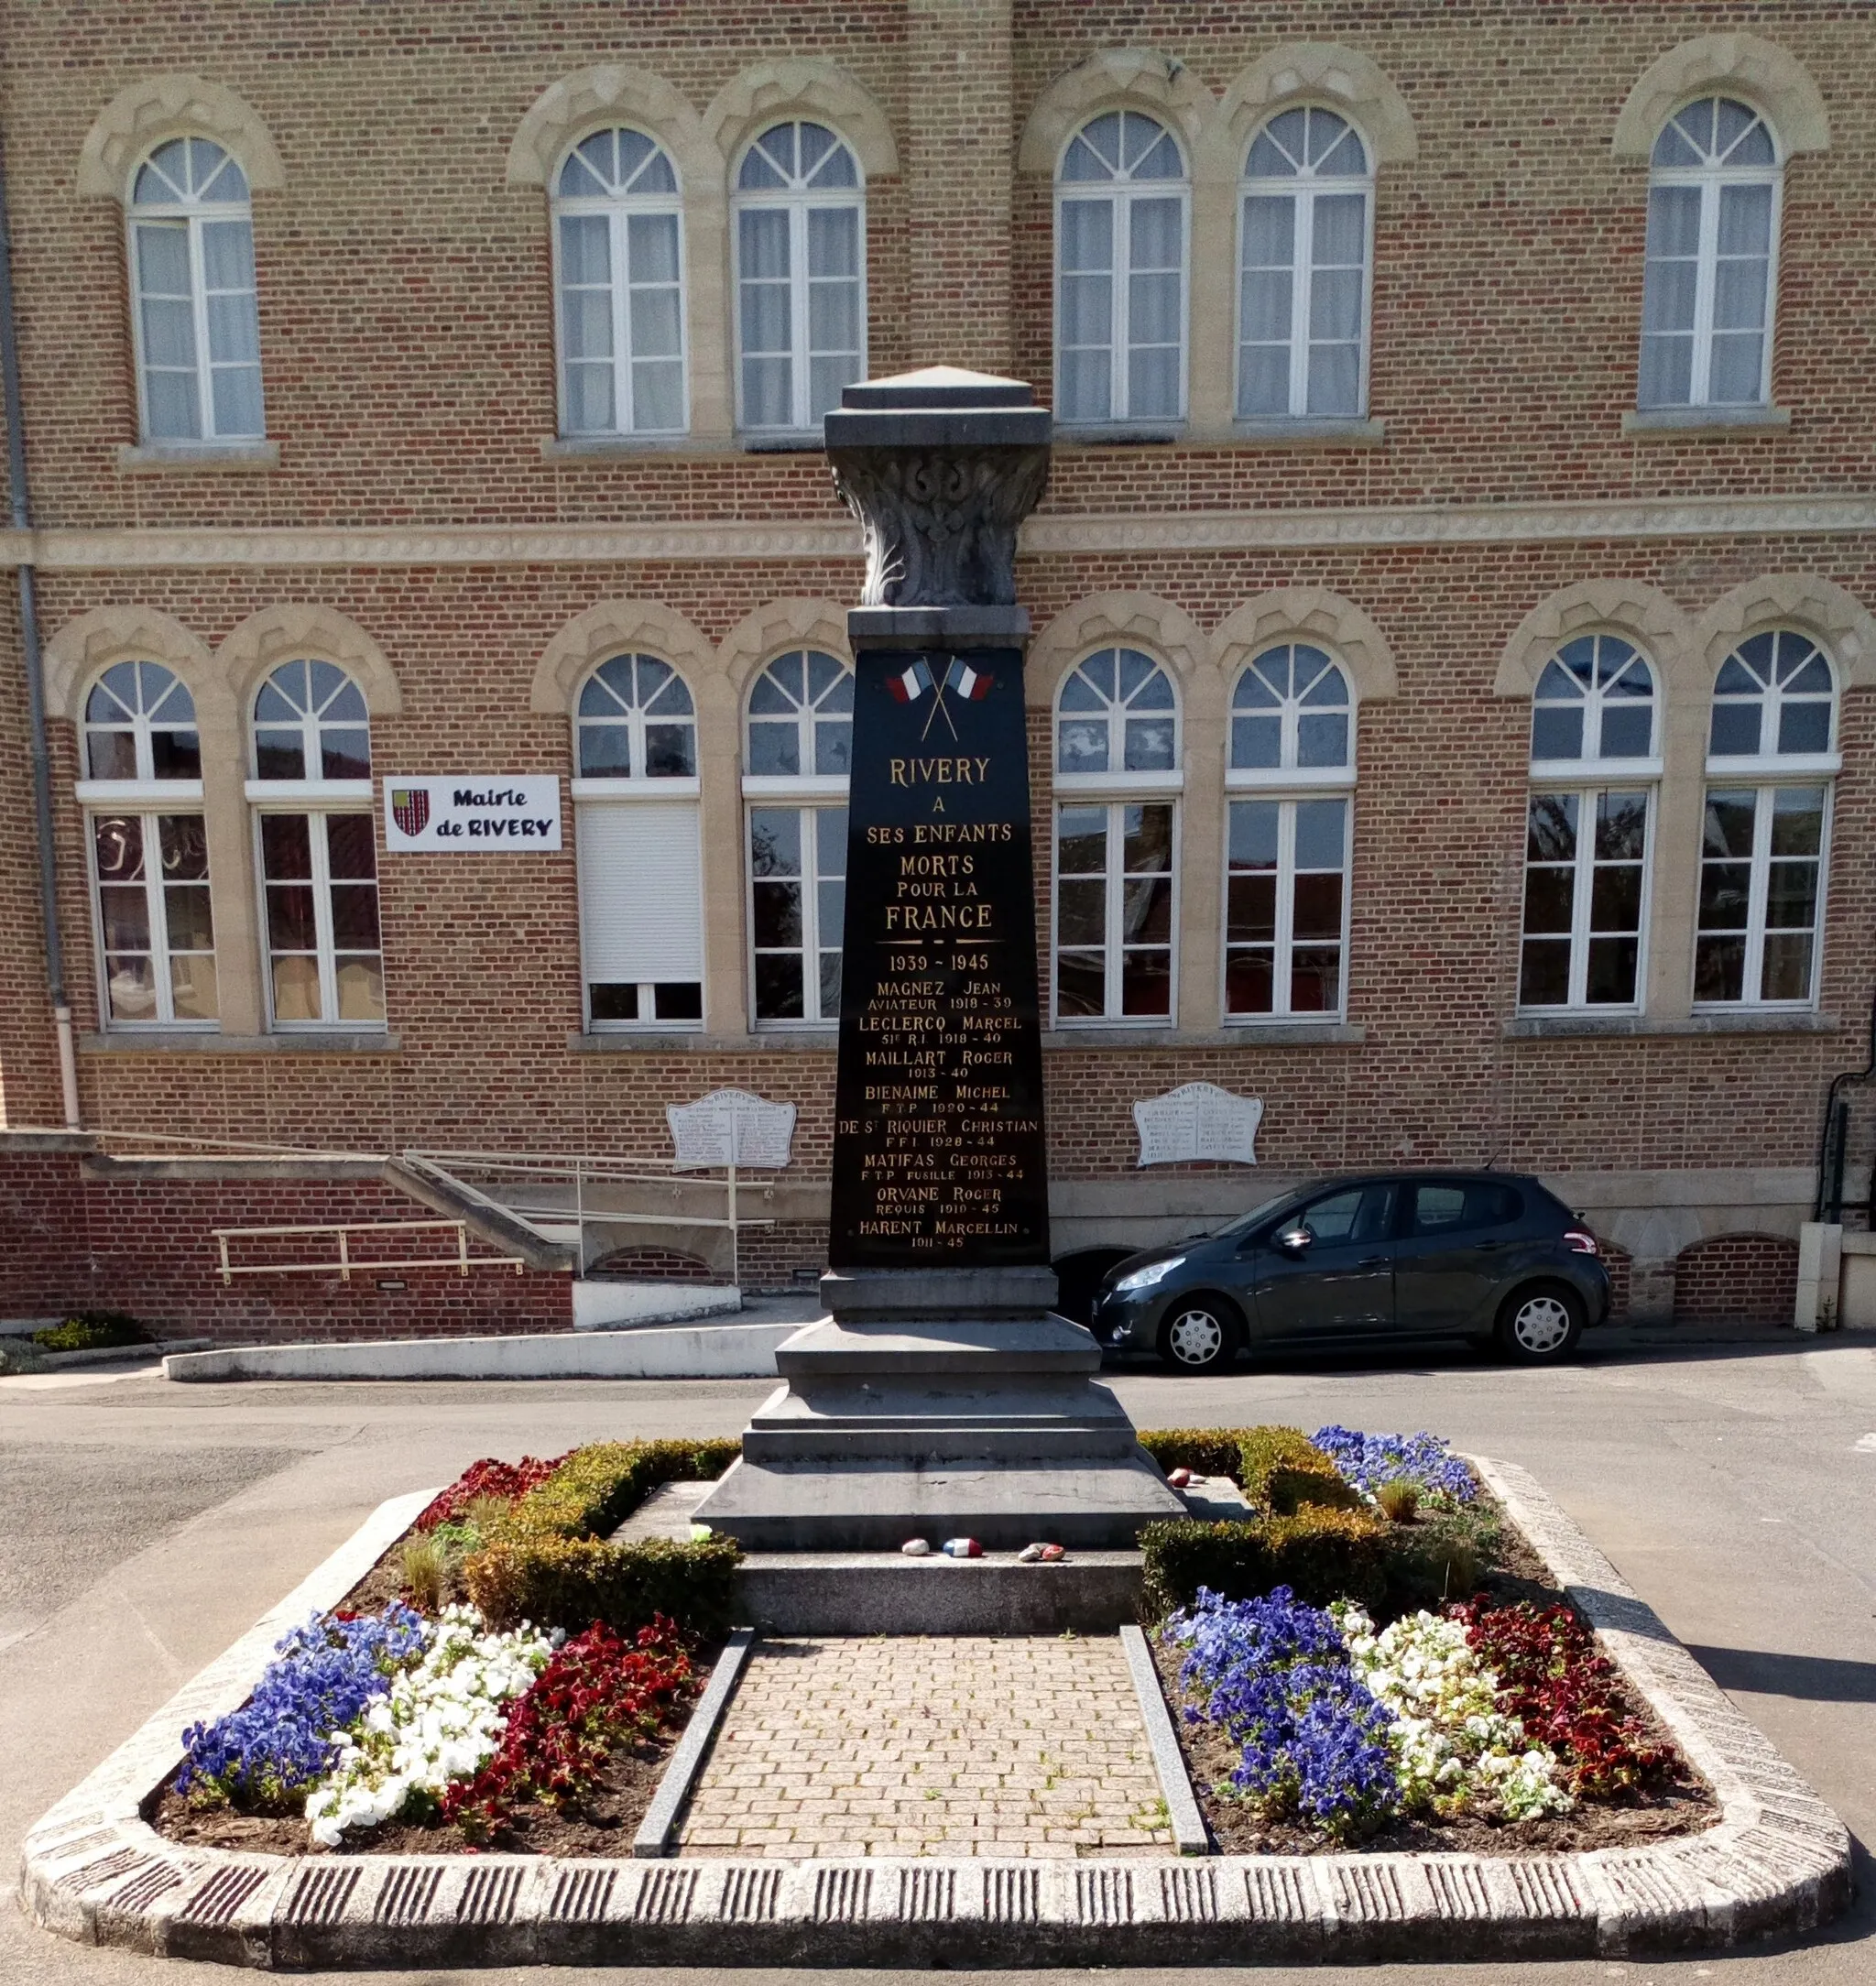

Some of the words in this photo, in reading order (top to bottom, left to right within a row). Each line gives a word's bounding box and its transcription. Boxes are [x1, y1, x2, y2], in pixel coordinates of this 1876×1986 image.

[889, 758, 991, 788] RIVERY
[453, 789, 528, 807] Mairie
[933, 796, 945, 813] A
[436, 819, 464, 837] de
[468, 819, 553, 837] RIVERY
[867, 826, 904, 844] SES
[914, 824, 1012, 844] ENFANTS
[900, 856, 974, 878] MORTS
[897, 882, 946, 898] POUR
[954, 882, 978, 897] LA
[886, 904, 992, 931] FRANCE
[890, 955, 928, 971] 1939
[951, 955, 989, 970] 1945
[877, 981, 944, 996] MAGNEZ
[963, 981, 1001, 995] JEAN
[867, 998, 937, 1011] AVIATEUR
[858, 1017, 946, 1032] LECLERCQ
[963, 1016, 1022, 1032] MARCEL
[983, 1032, 1001, 1043] 40
[866, 1051, 946, 1067] MAILLART
[963, 1051, 1013, 1066] ROGER
[951, 1067, 968, 1078] 40
[865, 1086, 939, 1099] BIENAIME
[955, 1085, 1010, 1099] MICHEL
[979, 1102, 998, 1112] 44
[839, 1120, 859, 1134] DE
[887, 1119, 947, 1136] RIQUIER
[961, 1118, 1038, 1134] CHRISTIAN
[976, 1136, 995, 1146] 44
[864, 1153, 934, 1168] MATIFAS
[949, 1153, 1017, 1167] GEORGES
[907, 1171, 956, 1181] FUSILLE
[1006, 1170, 1024, 1180] 44
[877, 1186, 939, 1204] ORVANE
[953, 1186, 1001, 1202] ROGER
[876, 1204, 926, 1217] REQUIS
[981, 1203, 999, 1214] 45
[859, 1220, 922, 1236] HARENT
[934, 1220, 1018, 1236] MARCELLIN
[947, 1237, 964, 1248] 45
